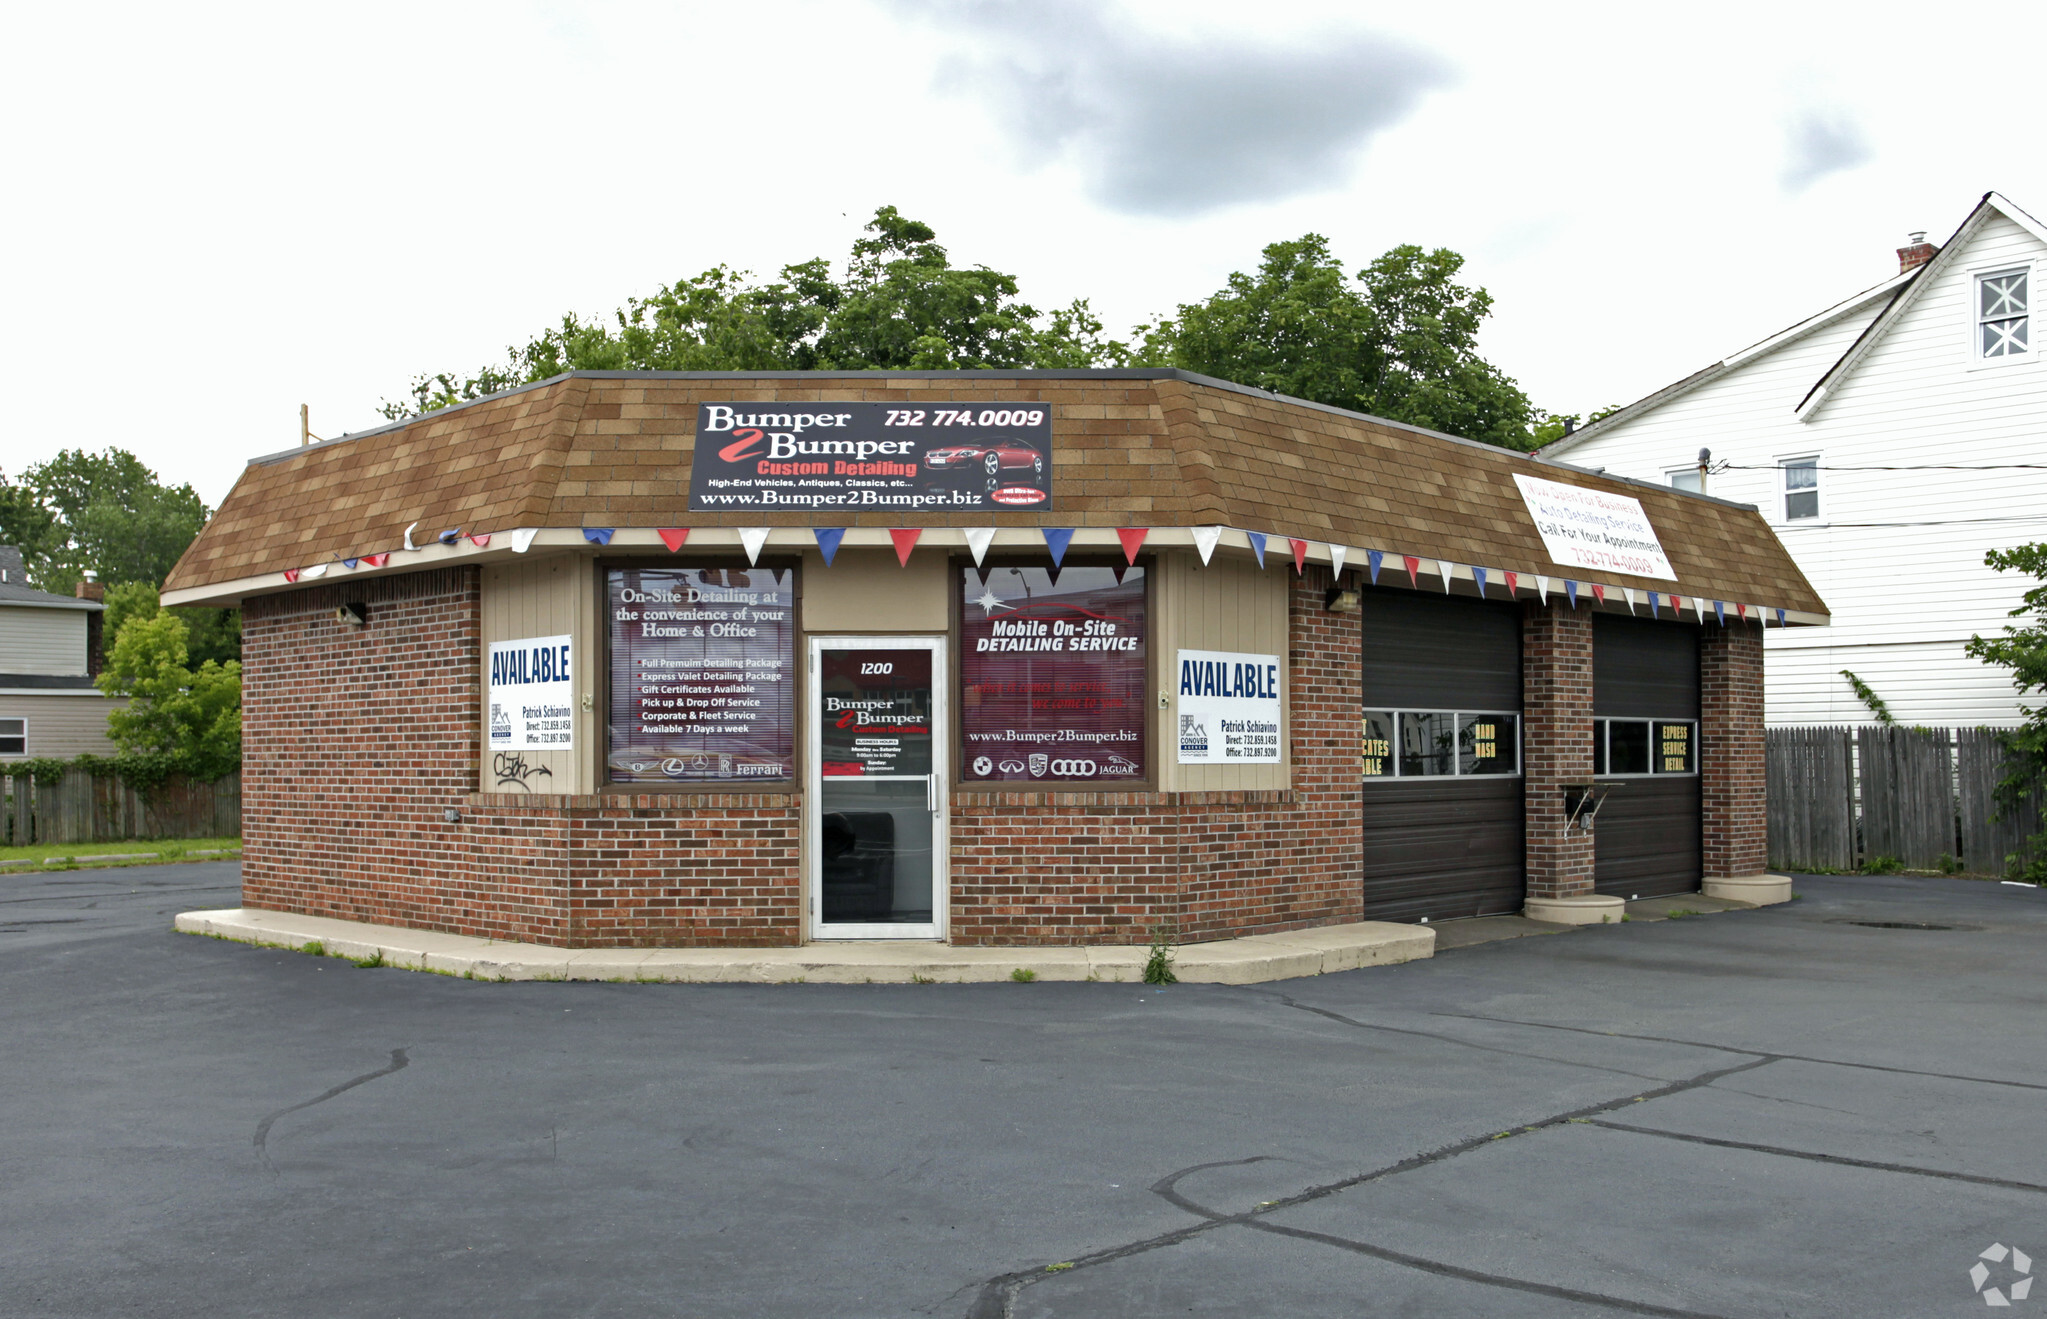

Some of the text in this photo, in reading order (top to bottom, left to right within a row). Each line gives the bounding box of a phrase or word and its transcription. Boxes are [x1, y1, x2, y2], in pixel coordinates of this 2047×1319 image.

[704, 406, 852, 432] Bumper
[884, 410, 1044, 426] 732 774.0009
[718, 428, 915, 462] 2 Bumper
[757, 460, 918, 477] Custom Detailing
[708, 479, 752, 488] High-End
[754, 479, 796, 487] Vehicles,
[798, 479, 843, 488] Antiques,
[845, 479, 888, 487] Classics,
[700, 490, 982, 507] www.Bumper2Bumper.biz
[1550, 485, 1577, 502] Open
[1577, 491, 1595, 506] For
[1597, 495, 1639, 515] Business
[1540, 503, 1564, 519] Auto
[1607, 515, 1645, 533] Service
[1538, 520, 1663, 554] Call For Your Appointment
[1571, 547, 1654, 574] 732-774-0009
[620, 588, 778, 605] On-Site Detailing at
[616, 607, 784, 623] the convenience of your
[641, 622, 757, 637] Home & Office
[992, 620, 1116, 637] Mobile On-Site
[976, 637, 1138, 652] DETAILING SERVICE
[491, 645, 570, 686] AVAILABLE
[642, 659, 658, 667] Full
[703, 659, 743, 669] Detailing
[745, 659, 782, 669] Package
[860, 663, 893, 675] 1200
[642, 672, 782, 682] Express Valet Detailing Package
[1180, 660, 1277, 699] AVAILABLE
[642, 685, 755, 694] Gift Certificates Available
[522, 704, 571, 718] Patrick Schiavino
[642, 699, 760, 709] Pick up & Drop Off Service
[826, 697, 894, 711] Bumper
[642, 711, 756, 721] Corporate & Fleet Service
[835, 709, 924, 728] 2 Bumper
[642, 725, 683, 733] Available
[686, 725, 691, 733] 7
[693, 725, 715, 735] Days
[724, 725, 749, 733] week
[852, 725, 928, 734] Custom Detailing
[1221, 719, 1277, 733] Patrick Schiavino
[1362, 718, 1367, 735] T
[1662, 725, 1688, 740] EXPRESS
[969, 729, 1138, 744] www.Bumper2Bumper.biz
[1225, 735, 1242, 745] Direct:
[1225, 747, 1242, 757] Office:
[1362, 739, 1389, 757] CATES
[736, 763, 783, 775] Ferrari
[1099, 765, 1134, 774] JAGUAR
[1362, 758, 1382, 775] ABLE
